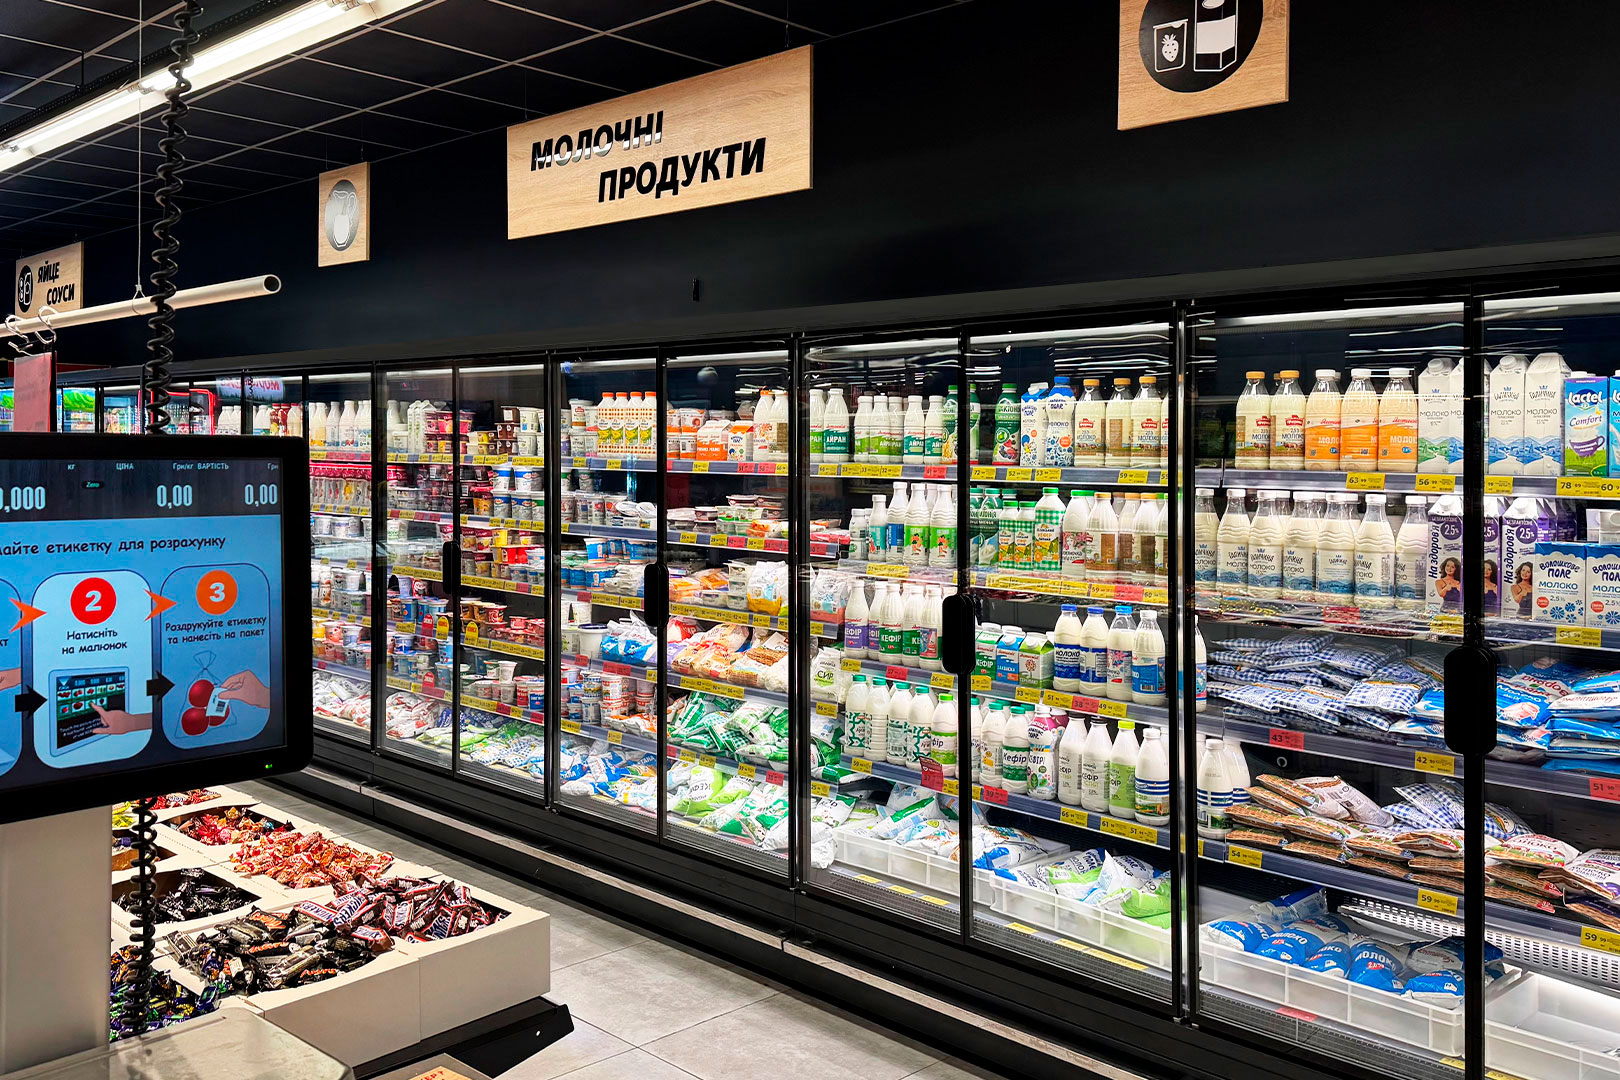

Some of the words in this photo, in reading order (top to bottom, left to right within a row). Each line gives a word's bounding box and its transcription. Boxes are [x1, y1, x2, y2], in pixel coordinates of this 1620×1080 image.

[530, 110, 664, 172] МОЛОЧНІ
[598, 137, 767, 203] ПРОДУКТИ
[37, 260, 60, 284] ЯЙЦЕ
[46, 288, 75, 306] СОУСИ
[1569, 414, 1602, 428] Comfort
[116, 461, 135, 471] ЦІНА
[197, 462, 229, 471] ВАРТІСТЬ
[1560, 481, 1572, 489] 78
[156, 484, 193, 509] 0,00
[244, 483, 278, 507] 0,00
[46, 540, 112, 554] етикетку
[118, 540, 144, 552] для
[150, 536, 226, 552] розрахунку
[1601, 571, 1620, 582] пол
[1538, 581, 1578, 590] МОЛОКО
[1592, 585, 1620, 593] МОЛО
[209, 582, 226, 603] 3
[84, 589, 102, 612] 2
[165, 619, 224, 632] Роздрукуйте
[226, 615, 267, 629] етикетку
[66, 628, 118, 641] Натисніть
[167, 635, 179, 645] та
[181, 631, 223, 643] нанесіть
[224, 631, 237, 641] на
[239, 628, 265, 638] пакет
[61, 645, 75, 655] на
[78, 641, 128, 653] малюнок
[817, 670, 834, 681] СИР
[1272, 734, 1283, 743] 43
[1003, 752, 1027, 764] Кефір
[1416, 755, 1427, 764] 42
[1593, 782, 1604, 791] 51
[1421, 894, 1432, 903] 59
[1585, 933, 1597, 942] 59
